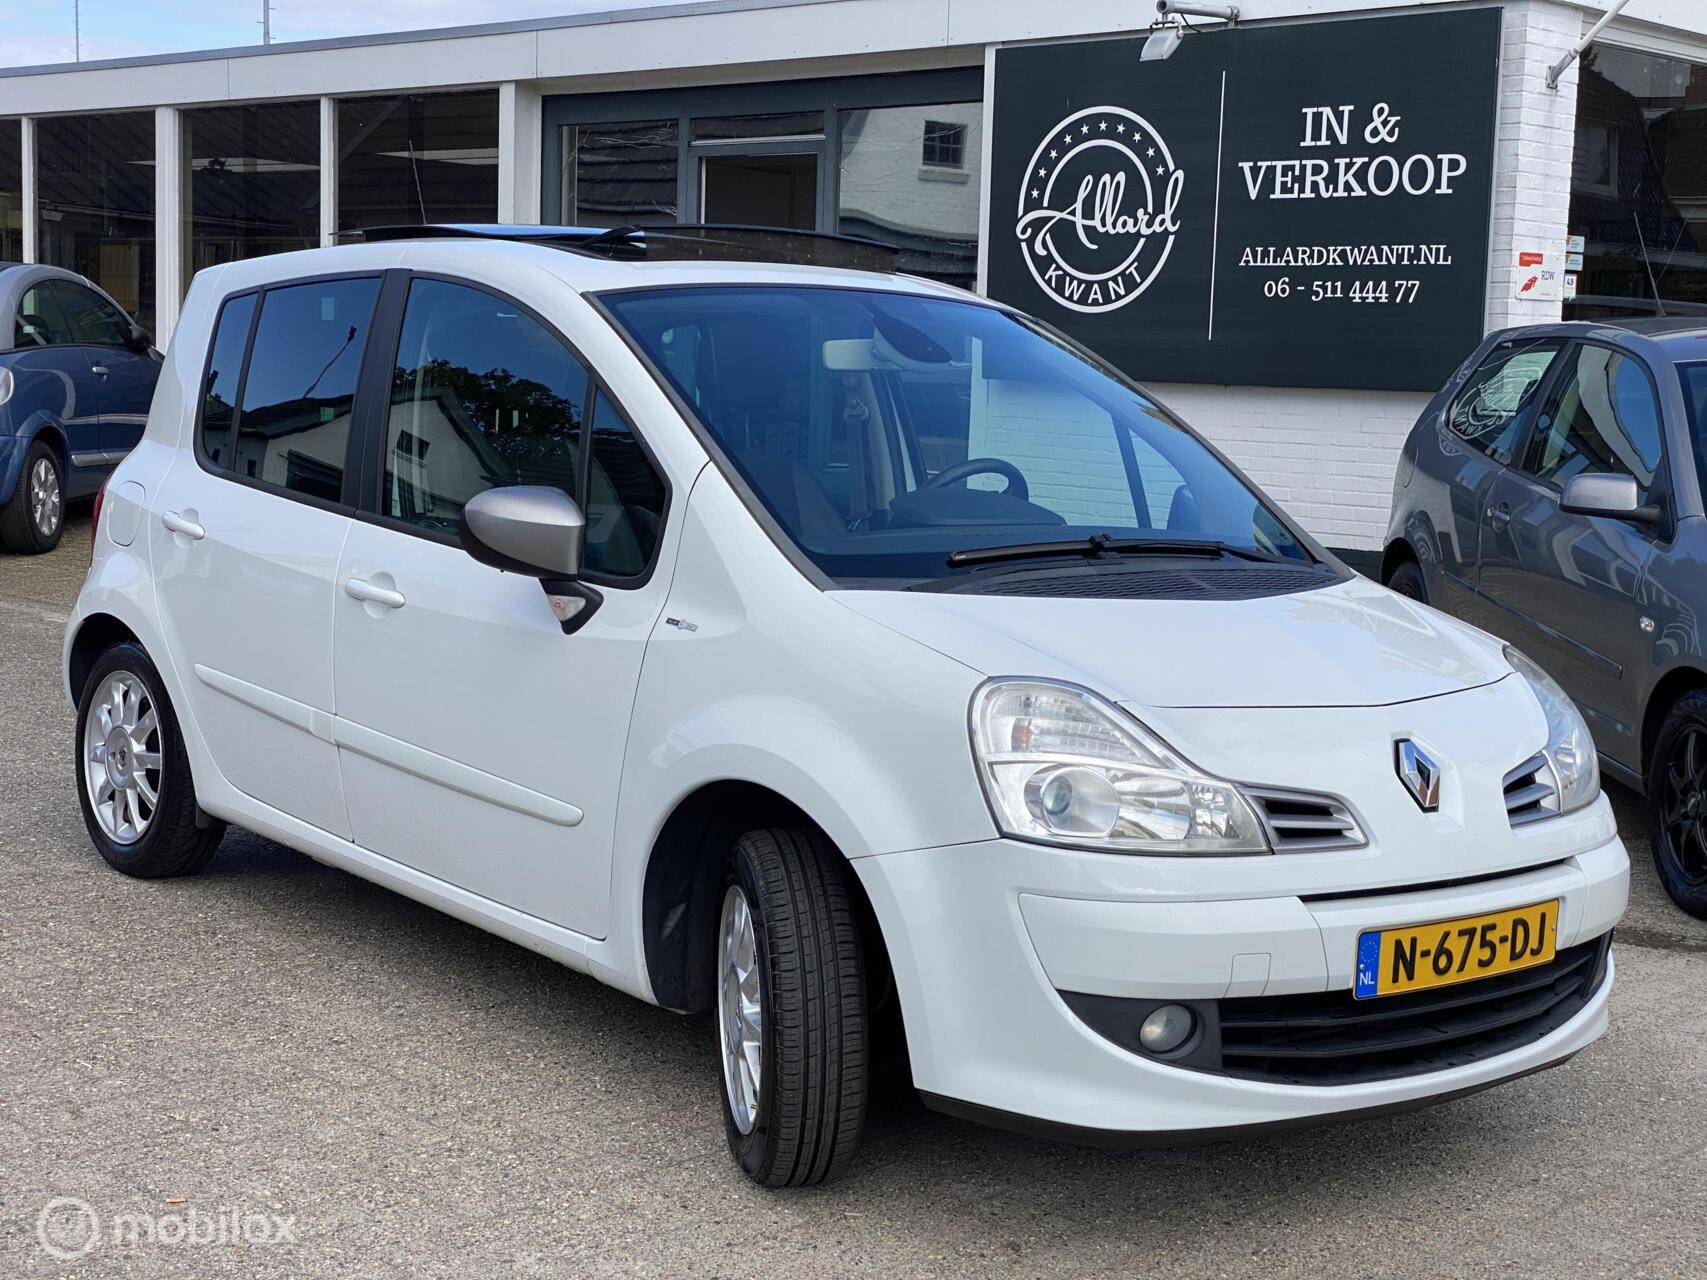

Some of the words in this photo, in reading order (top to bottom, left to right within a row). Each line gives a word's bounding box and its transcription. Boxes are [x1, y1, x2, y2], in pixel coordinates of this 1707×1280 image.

[1300, 105, 1354, 146] IN
[1364, 102, 1401, 144] &
[1238, 153, 1467, 200] VERKOOP
[1015, 169, 1185, 256] Allard
[1238, 244, 1453, 266] ALLARDKWANT.NL
[1044, 261, 1142, 304] KWANT
[1263, 277, 1290, 298] 06
[1311, 280, 1344, 302] 511
[1349, 280, 1389, 303] 444
[1394, 280, 1421, 304] 77
[1391, 912, 1547, 984] N-675-DJ
[1359, 971, 1376, 987] NL
